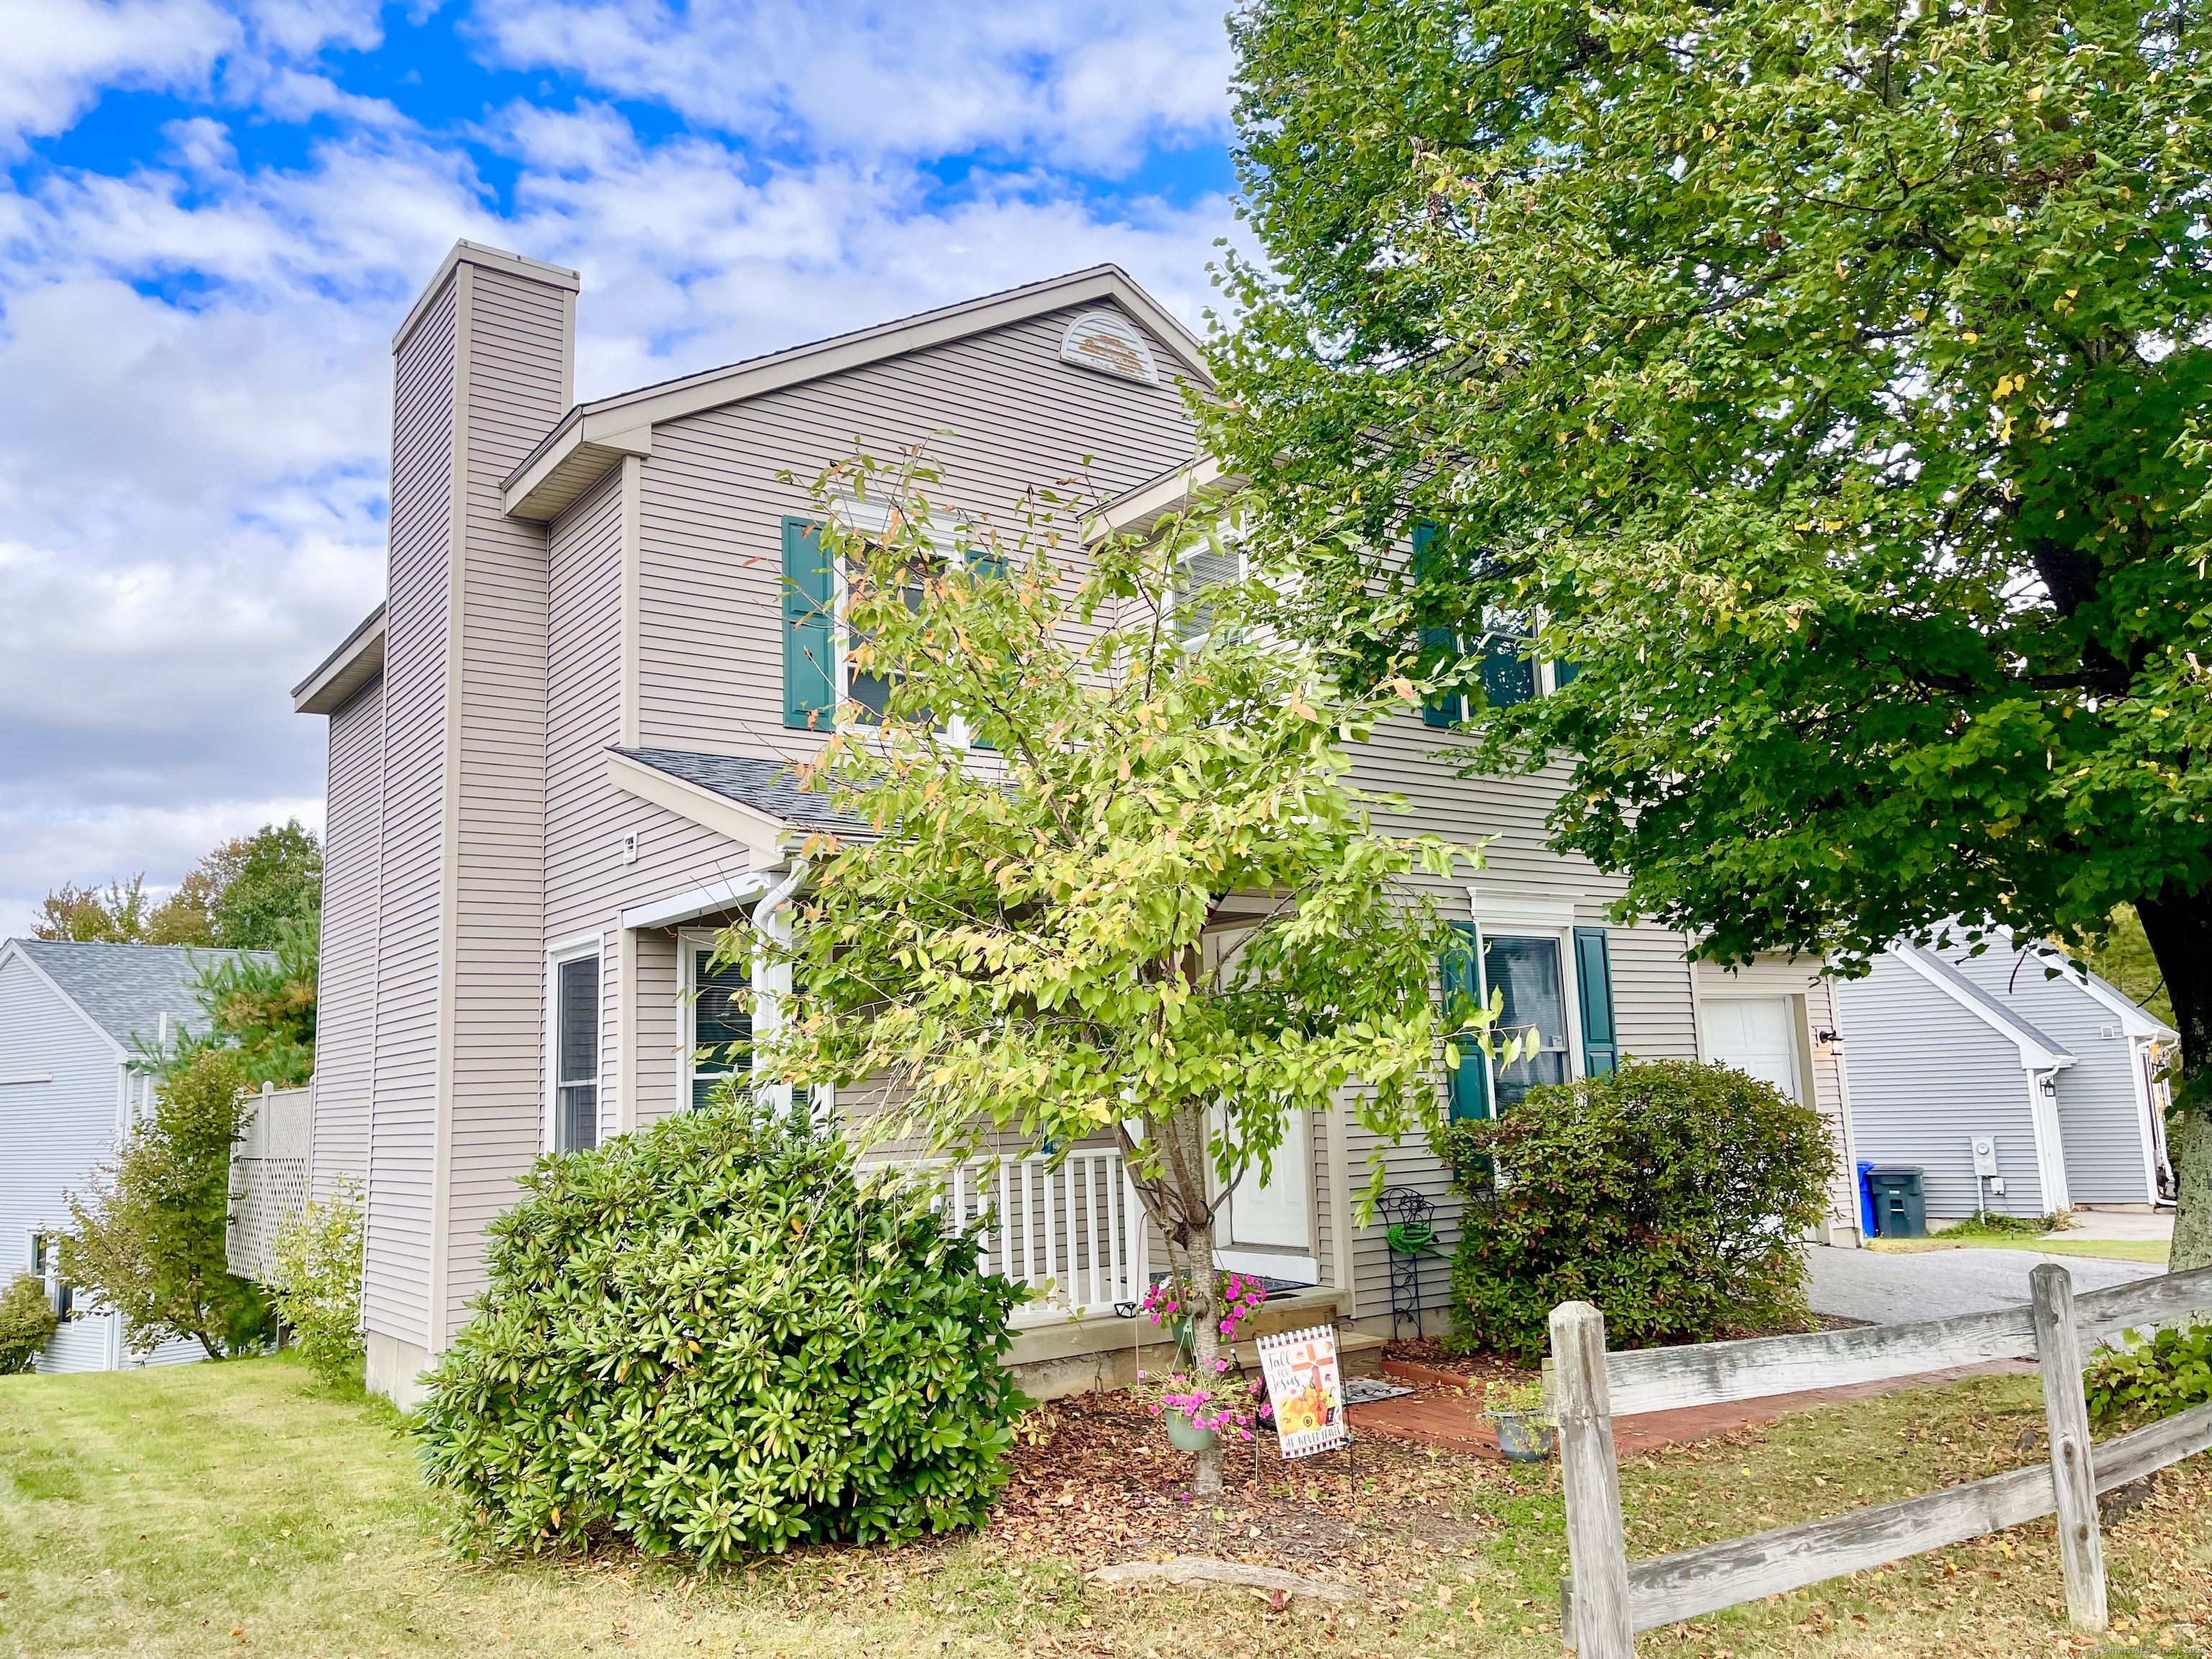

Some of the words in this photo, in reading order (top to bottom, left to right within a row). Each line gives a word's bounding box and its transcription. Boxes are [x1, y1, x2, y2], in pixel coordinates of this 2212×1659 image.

[1266, 1349, 1293, 1371] Fall
[1277, 1367, 1290, 1377] FOR
[1268, 1375, 1300, 1394] Jesus
[1285, 1437, 1295, 1449] HE
[1298, 1432, 1320, 1446] NEVER
[1322, 1425, 1341, 1440] LEAVES
